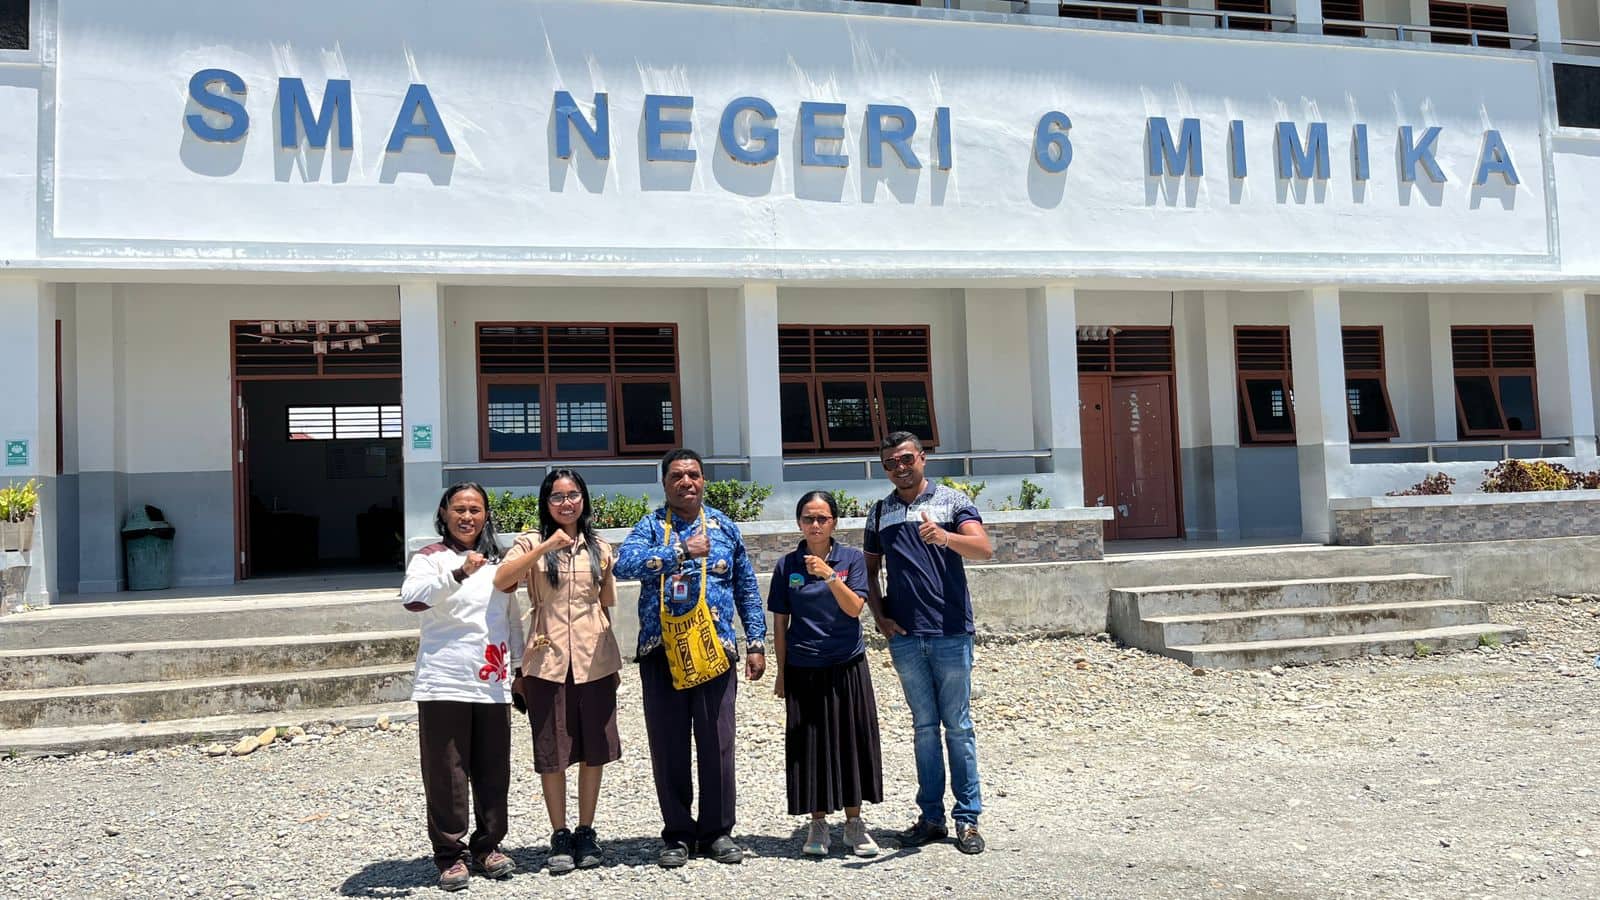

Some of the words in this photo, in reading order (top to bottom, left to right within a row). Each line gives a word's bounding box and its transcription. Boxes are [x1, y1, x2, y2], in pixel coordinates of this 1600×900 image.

[185, 68, 455, 155] SMA
[554, 90, 952, 170] NEGERI
[1034, 110, 1073, 173] 6
[1146, 116, 1521, 185] MIMIKA
